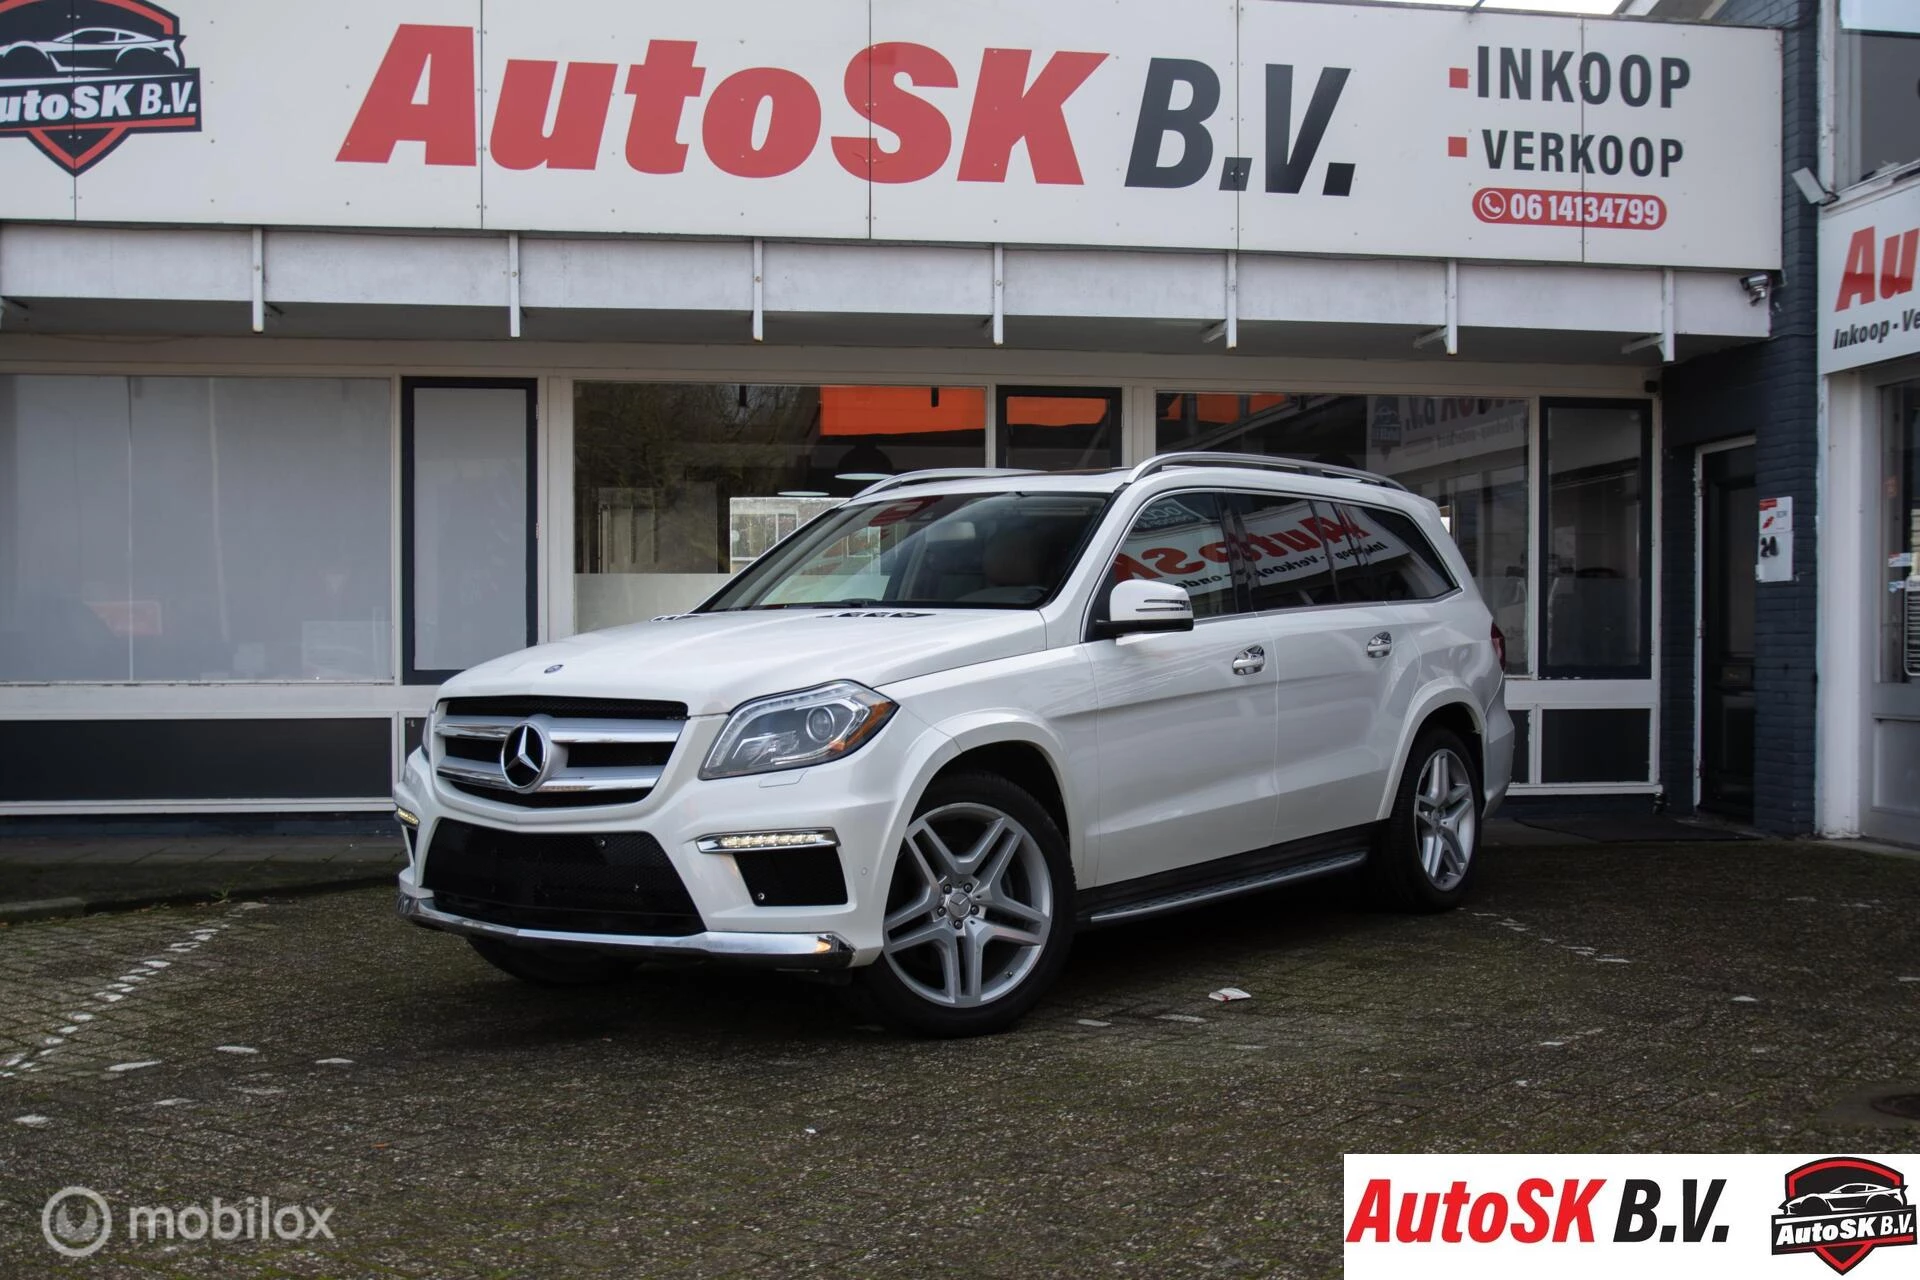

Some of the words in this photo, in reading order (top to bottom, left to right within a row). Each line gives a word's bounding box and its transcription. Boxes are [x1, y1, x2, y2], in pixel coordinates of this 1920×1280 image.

[1477, 45, 1691, 109] INKOOP
[0, 85, 135, 123] utoSK
[139, 81, 198, 115] B.V.
[336, 24, 1109, 185] AutoSK
[1124, 57, 1356, 197] B.V.
[1481, 129, 1684, 178] VERKOOP
[1510, 193, 1543, 220] 06
[1548, 195, 1660, 226] 14134799
[1834, 225, 1920, 312] Au
[1832, 319, 1890, 350] Inkoop
[1902, 308, 1920, 332] Ve
